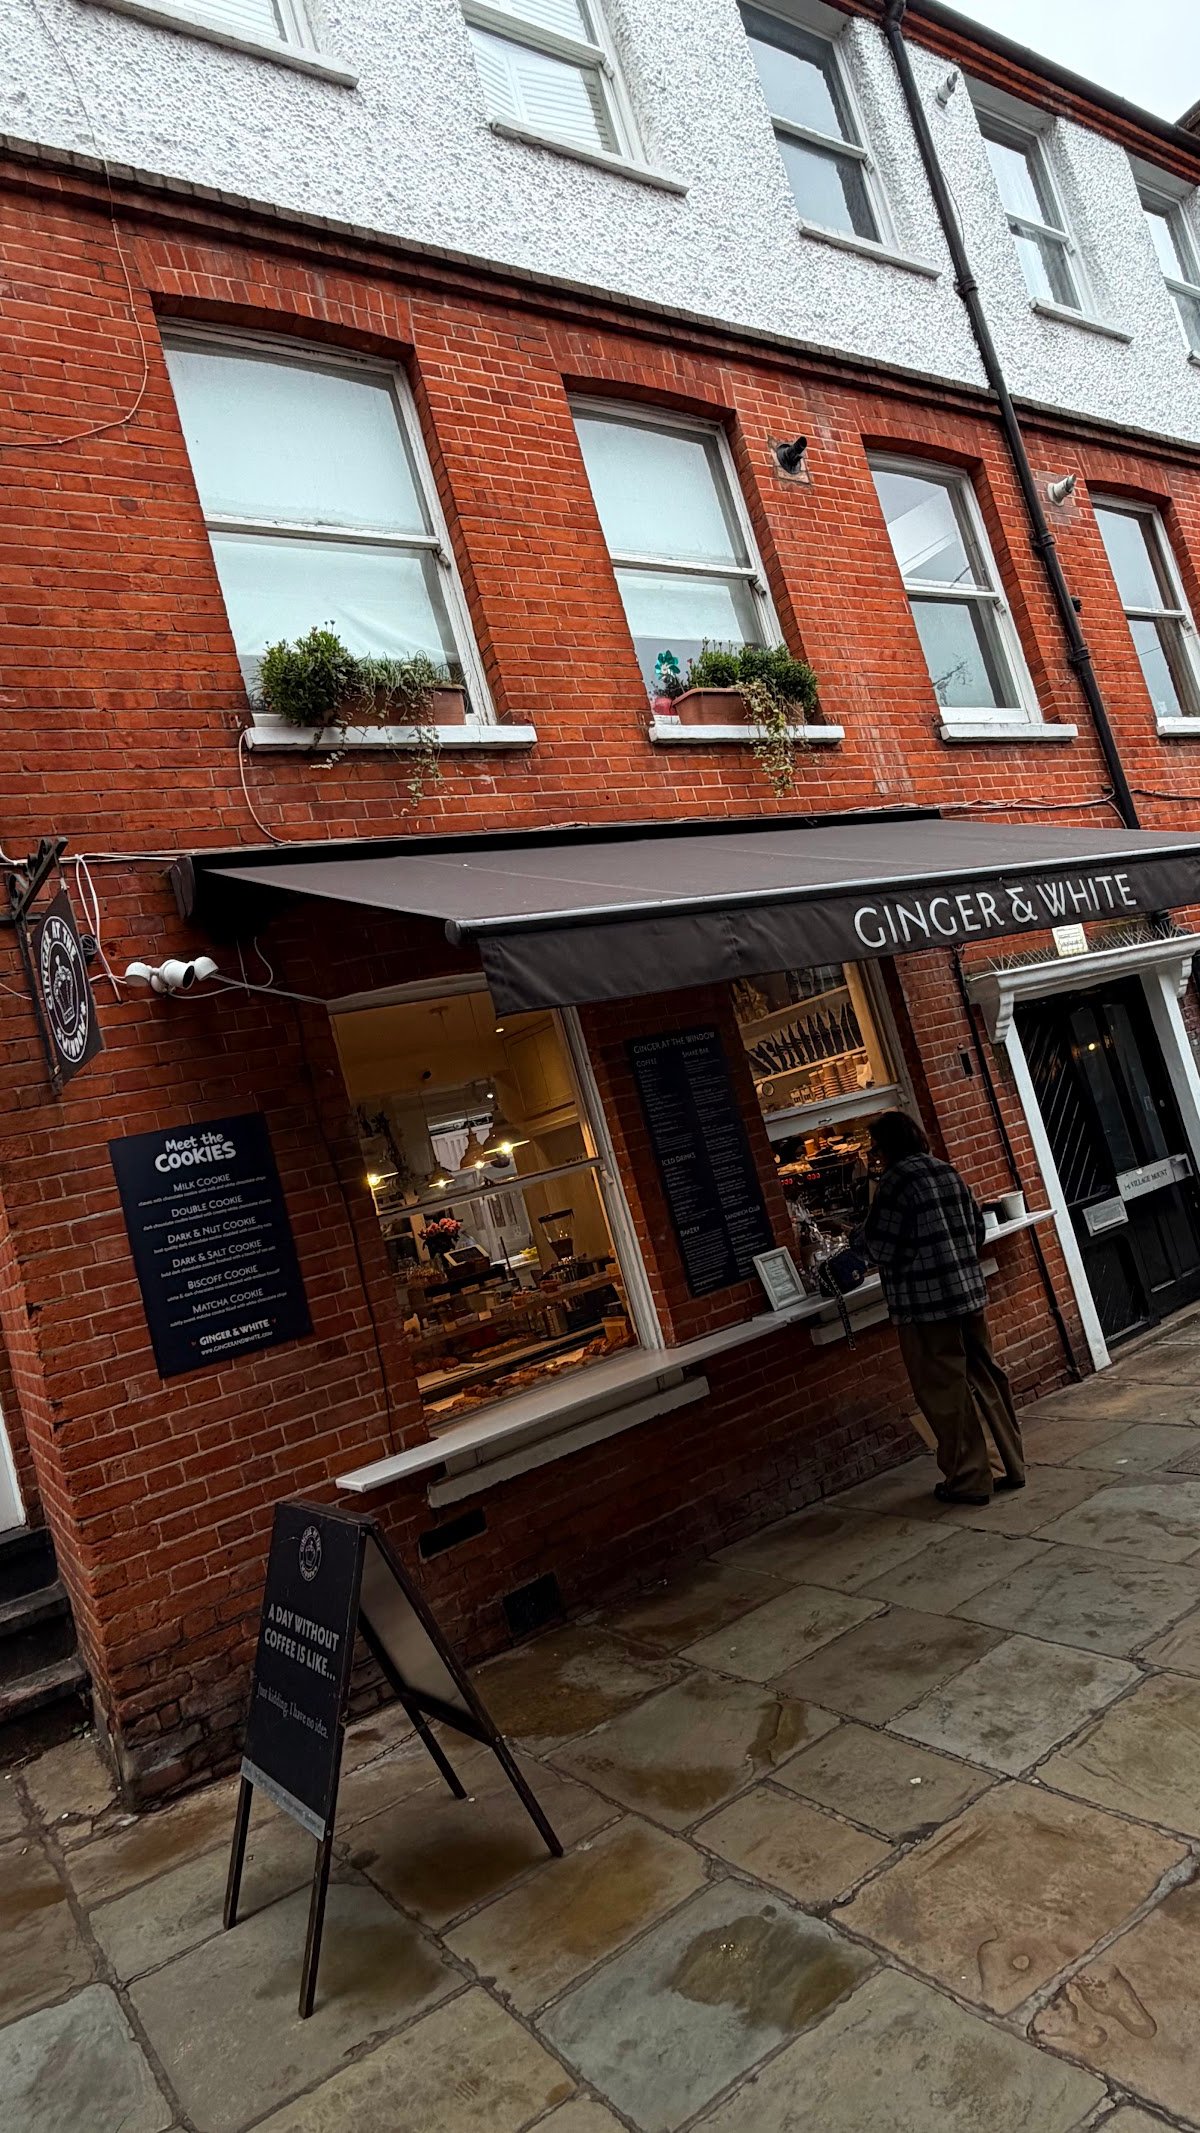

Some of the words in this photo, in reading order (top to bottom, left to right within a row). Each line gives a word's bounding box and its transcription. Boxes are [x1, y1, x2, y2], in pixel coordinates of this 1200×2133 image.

[853, 890, 1005, 948] GINGER
[1010, 886, 1038, 923] &
[1036, 873, 1137, 919] WHITE
[42, 930, 52, 1010] GINGER
[51, 920, 61, 939] AT
[62, 925, 77, 962] THE
[61, 1013, 86, 1057] WINDOW
[165, 1136, 198, 1152] Meet
[200, 1132, 224, 1145] the
[155, 1141, 236, 1172] COOKIES
[173, 1181, 195, 1192] MILK
[196, 1173, 230, 1187] COOKIE
[171, 1203, 207, 1217] DOUBLE
[209, 1195, 243, 1209] COOKIE
[167, 1231, 192, 1244] DARK
[193, 1229, 201, 1238] &
[202, 1224, 221, 1236] NUT
[223, 1216, 256, 1230] COOKIE
[172, 1256, 196, 1268] DARK
[198, 1253, 206, 1261] &
[207, 1248, 227, 1260] SALT
[228, 1239, 262, 1254] COOKIE
[187, 1273, 222, 1290] BISCOFF
[224, 1265, 258, 1280] COOKIE
[192, 1298, 229, 1314] MATCHA
[230, 1288, 264, 1303] COOKIE
[199, 1330, 232, 1346] GINGER
[232, 1328, 240, 1337] &
[240, 1319, 270, 1333] WHITE
[268, 1603, 274, 1620] A
[276, 1606, 294, 1629] DAY
[294, 1614, 339, 1652] WITHOUT
[264, 1627, 296, 1659] COFFEE
[296, 1644, 306, 1664] IS
[306, 1649, 336, 1681] LIKE...
[293, 1703, 306, 1724] have
[306, 1717, 314, 1729] no
